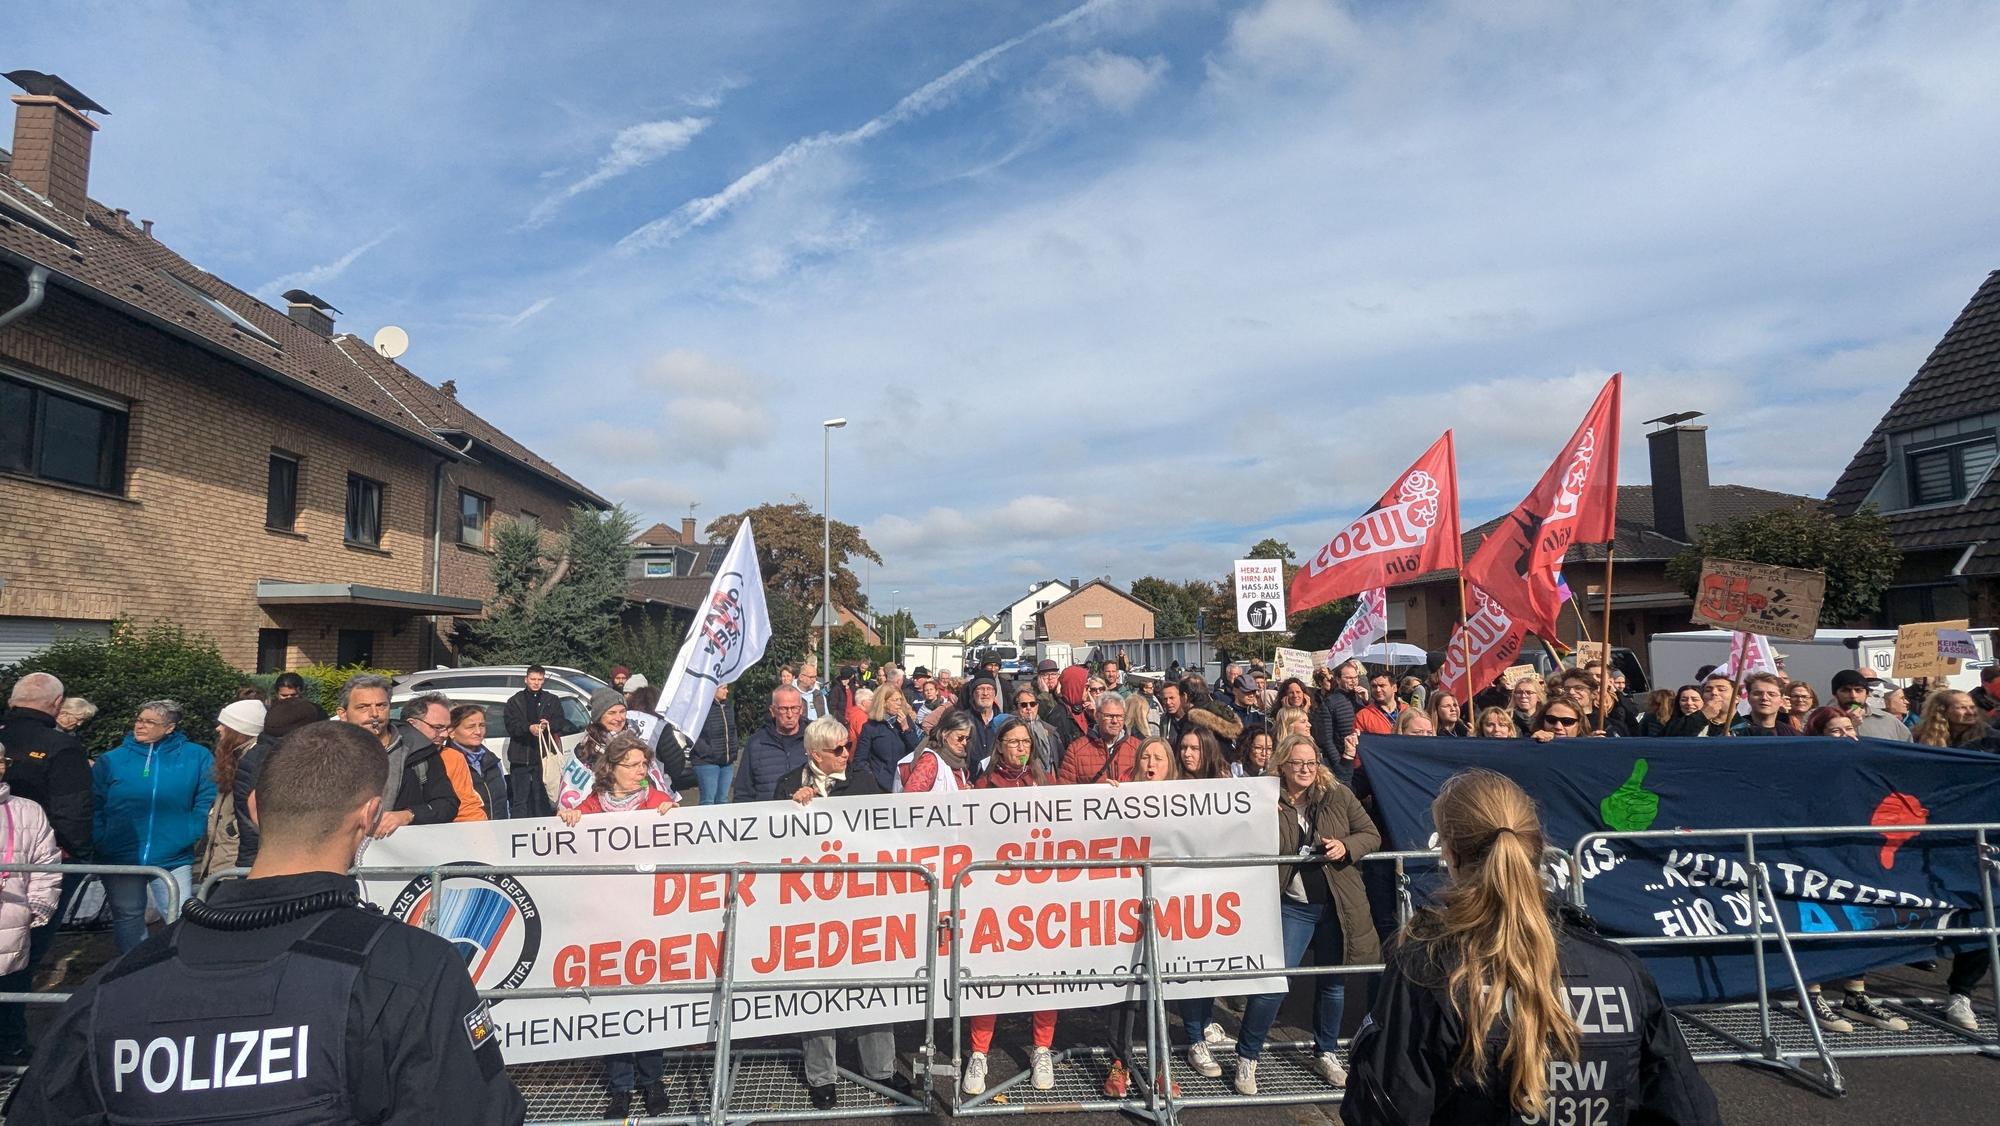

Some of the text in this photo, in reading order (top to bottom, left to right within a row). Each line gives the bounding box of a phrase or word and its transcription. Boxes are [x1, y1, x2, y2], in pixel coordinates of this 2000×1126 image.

[1260, 591, 1281, 599] RAUS
[1874, 654, 1891, 668] 100
[511, 790, 1252, 859] FÜR TOLERANZ UND VIELFALT OHNE RASSISMUS
[653, 828, 1152, 916] DER KÖLNER SÜDEN
[392, 891, 415, 920] AZIS
[500, 878, 536, 920] GEFAHR
[1653, 897, 1729, 937] FÜR
[553, 891, 1242, 989] GEGEN JEDEN FASCHISMUS
[502, 960, 533, 991] NTIFA
[731, 985, 928, 1023] DEMOKRATIE
[1016, 967, 1105, 997] KLIMA
[113, 1024, 309, 1094] POLIZEI
[1550, 1060, 1608, 1092] RW
